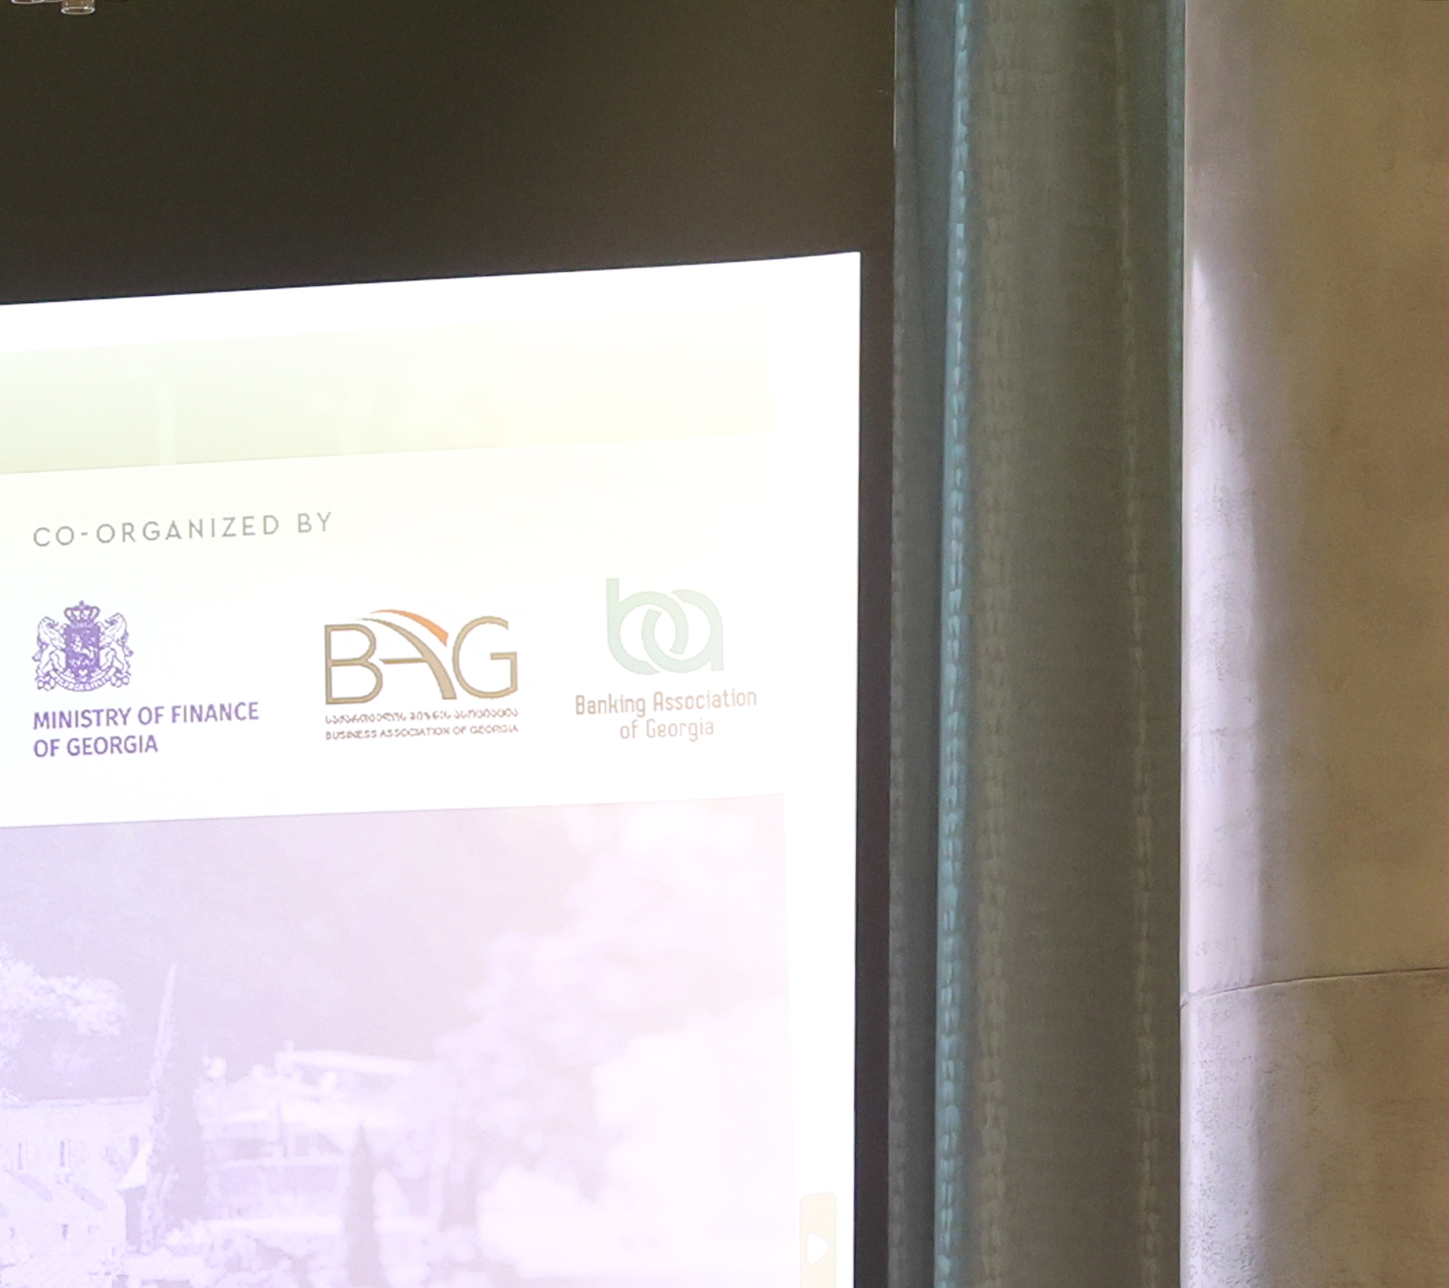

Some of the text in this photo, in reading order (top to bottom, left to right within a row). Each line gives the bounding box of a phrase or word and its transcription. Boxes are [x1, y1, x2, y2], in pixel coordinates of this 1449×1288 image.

[33, 512, 332, 547] CO-ORGANIZED BY
[33, 702, 259, 730] MINISTRY OF FINANCE
[576, 689, 757, 718] Banking Association
[326, 724, 518, 740] BUSINESS ASSOCIATION OF GEORGIA
[620, 718, 714, 742] of Georgia
[33, 735, 158, 757] OF GEORGIA
